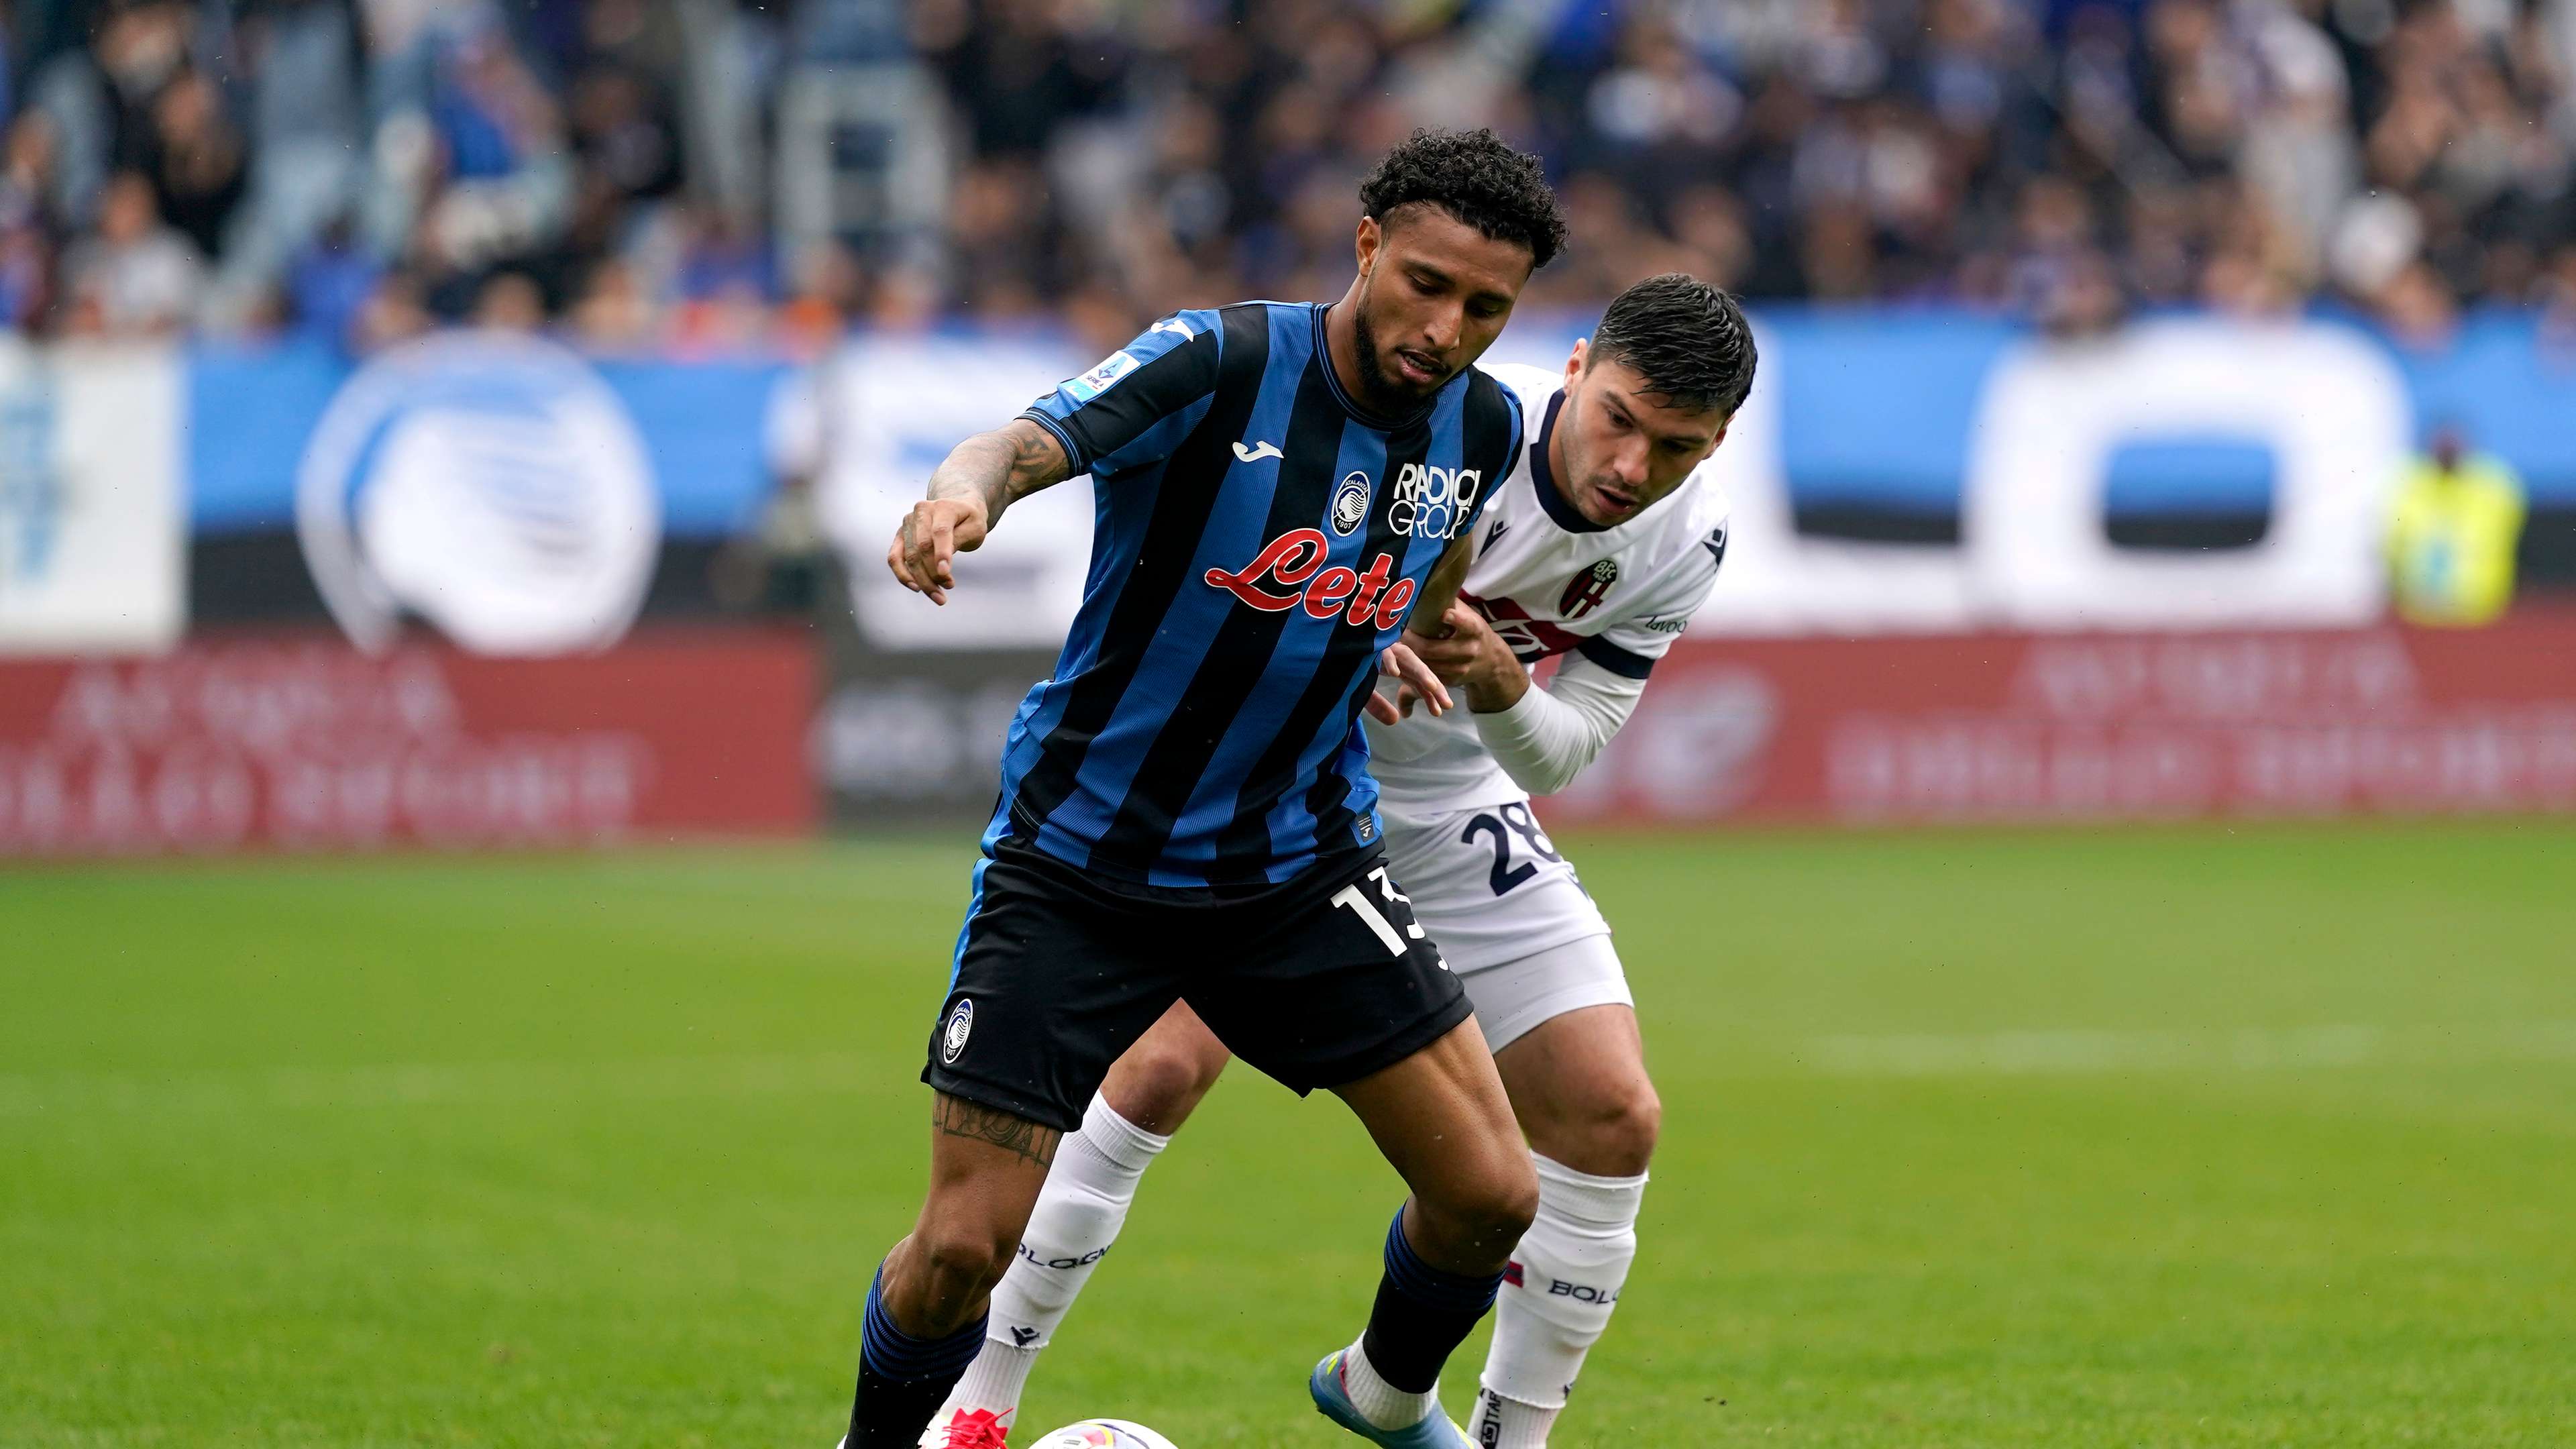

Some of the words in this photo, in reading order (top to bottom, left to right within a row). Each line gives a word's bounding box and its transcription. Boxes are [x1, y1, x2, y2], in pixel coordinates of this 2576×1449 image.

[1345, 480, 1368, 491] ATALANTA
[1393, 462, 1481, 506] RADICI
[1337, 519, 1352, 529] 1907
[1388, 499, 1470, 540] GROUP
[1205, 528, 1415, 631] Lete
[1461, 802, 1564, 897] 28
[1330, 867, 1426, 958] 13
